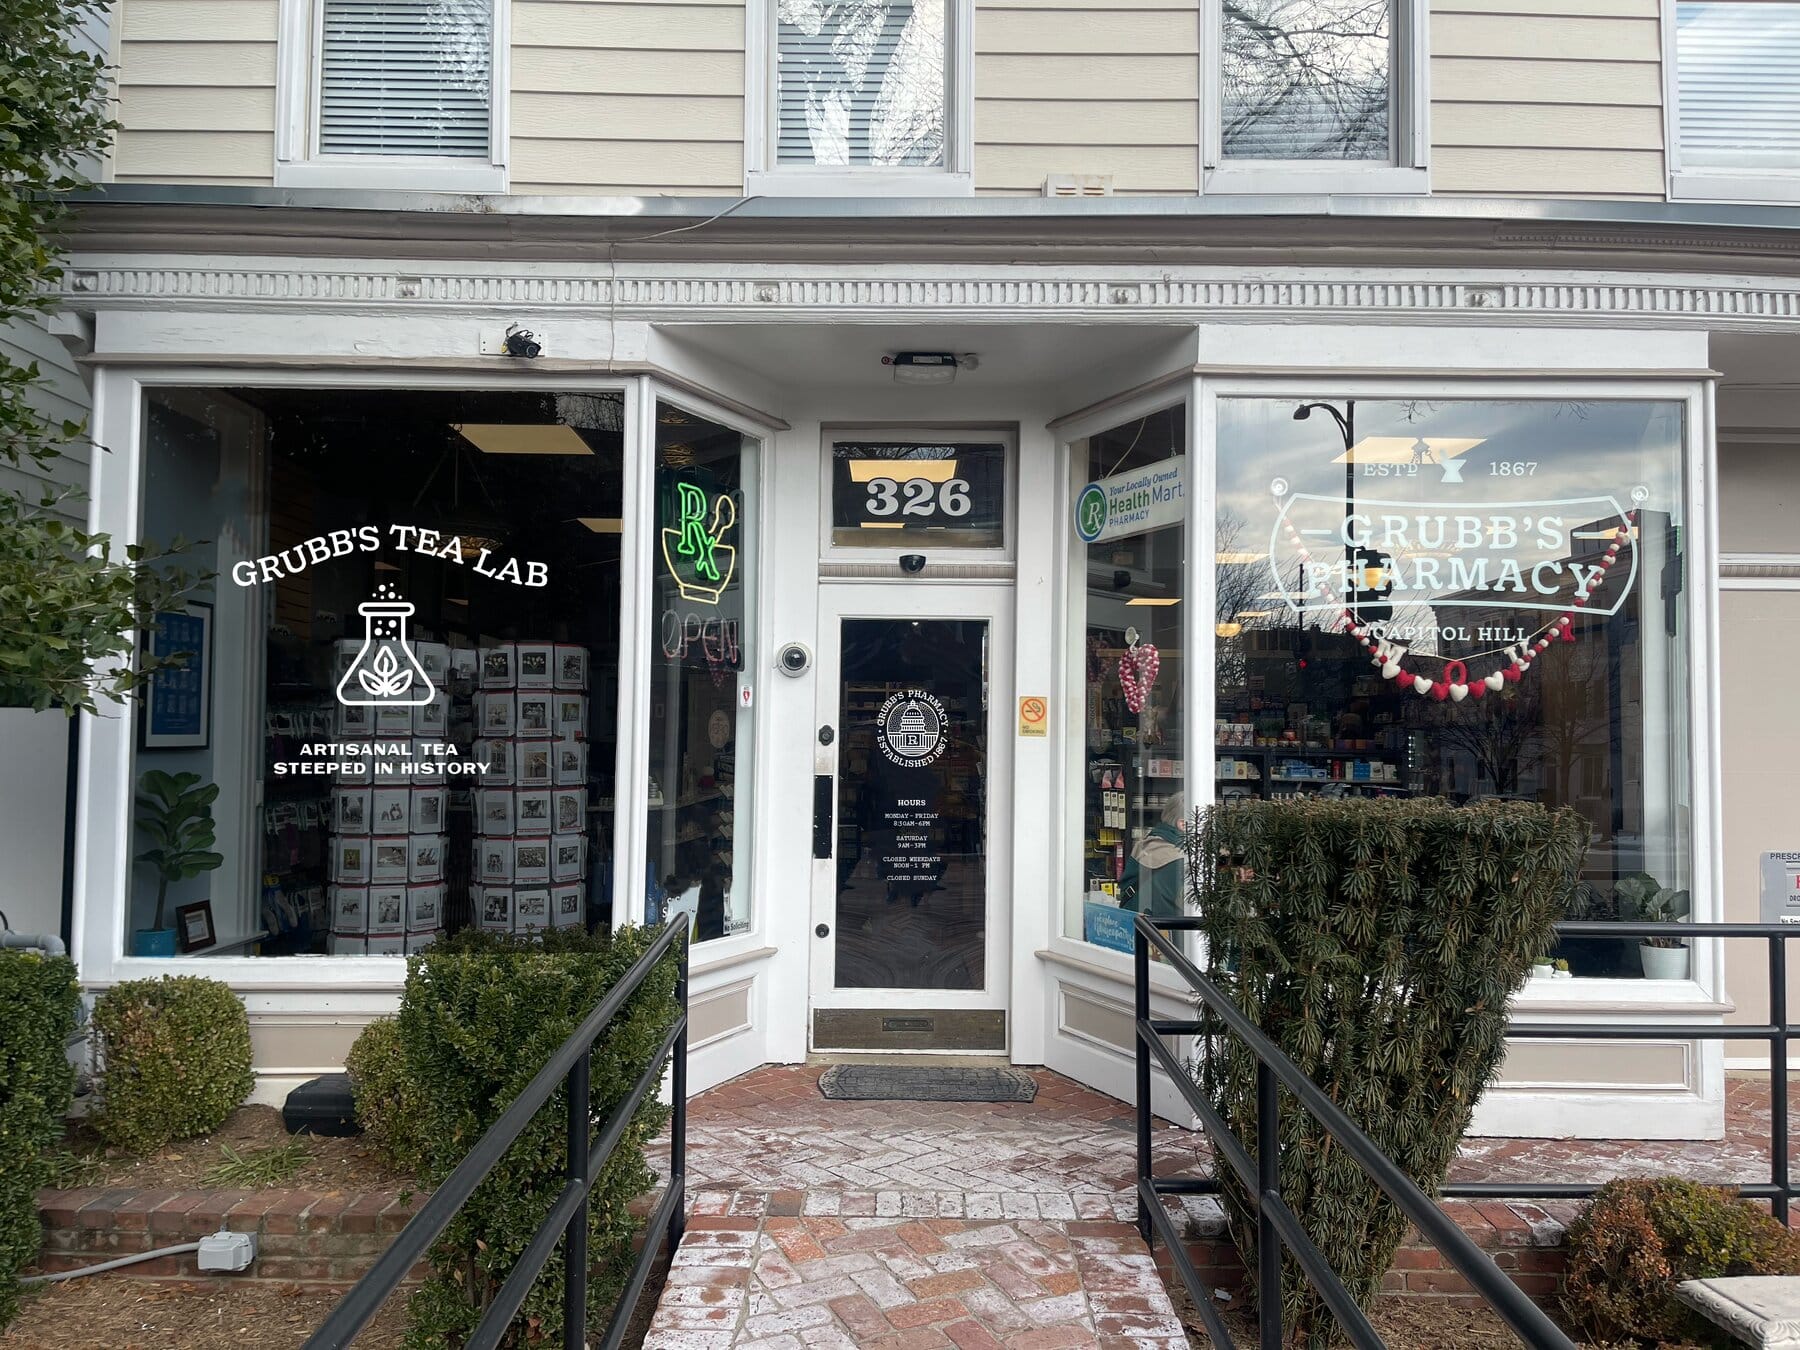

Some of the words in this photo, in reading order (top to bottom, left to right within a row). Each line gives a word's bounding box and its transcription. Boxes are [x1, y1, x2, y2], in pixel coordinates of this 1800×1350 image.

[1109, 485, 1126, 497] Your
[1126, 476, 1152, 492] Locally
[1152, 468, 1178, 484] Owned
[1489, 462, 1538, 477] 1867
[865, 477, 972, 517] 326
[1109, 490, 1150, 516] Health
[1109, 509, 1150, 528] PHARMACY
[1340, 513, 1564, 550] GRUBB'S
[231, 524, 381, 588] GRUBB'S
[388, 523, 466, 566] TEA
[472, 547, 549, 588] LAB
[1303, 557, 1601, 599] PHARMACY
[661, 609, 738, 664] OPEN
[1372, 626, 1472, 642] CAPITOL
[1477, 627, 1529, 641] HILL
[876, 691, 905, 727] GRUBB'S
[907, 689, 949, 727] PHARMACY
[299, 743, 413, 757] ARTISANAL
[420, 743, 459, 757] TEA
[877, 735, 935, 768] ESTABLISHED
[935, 736, 949, 758] 1867
[272, 761, 367, 776] STEEPED
[373, 761, 394, 776] IN
[400, 761, 492, 776] HISTORY
[897, 799, 927, 807] HOURS
